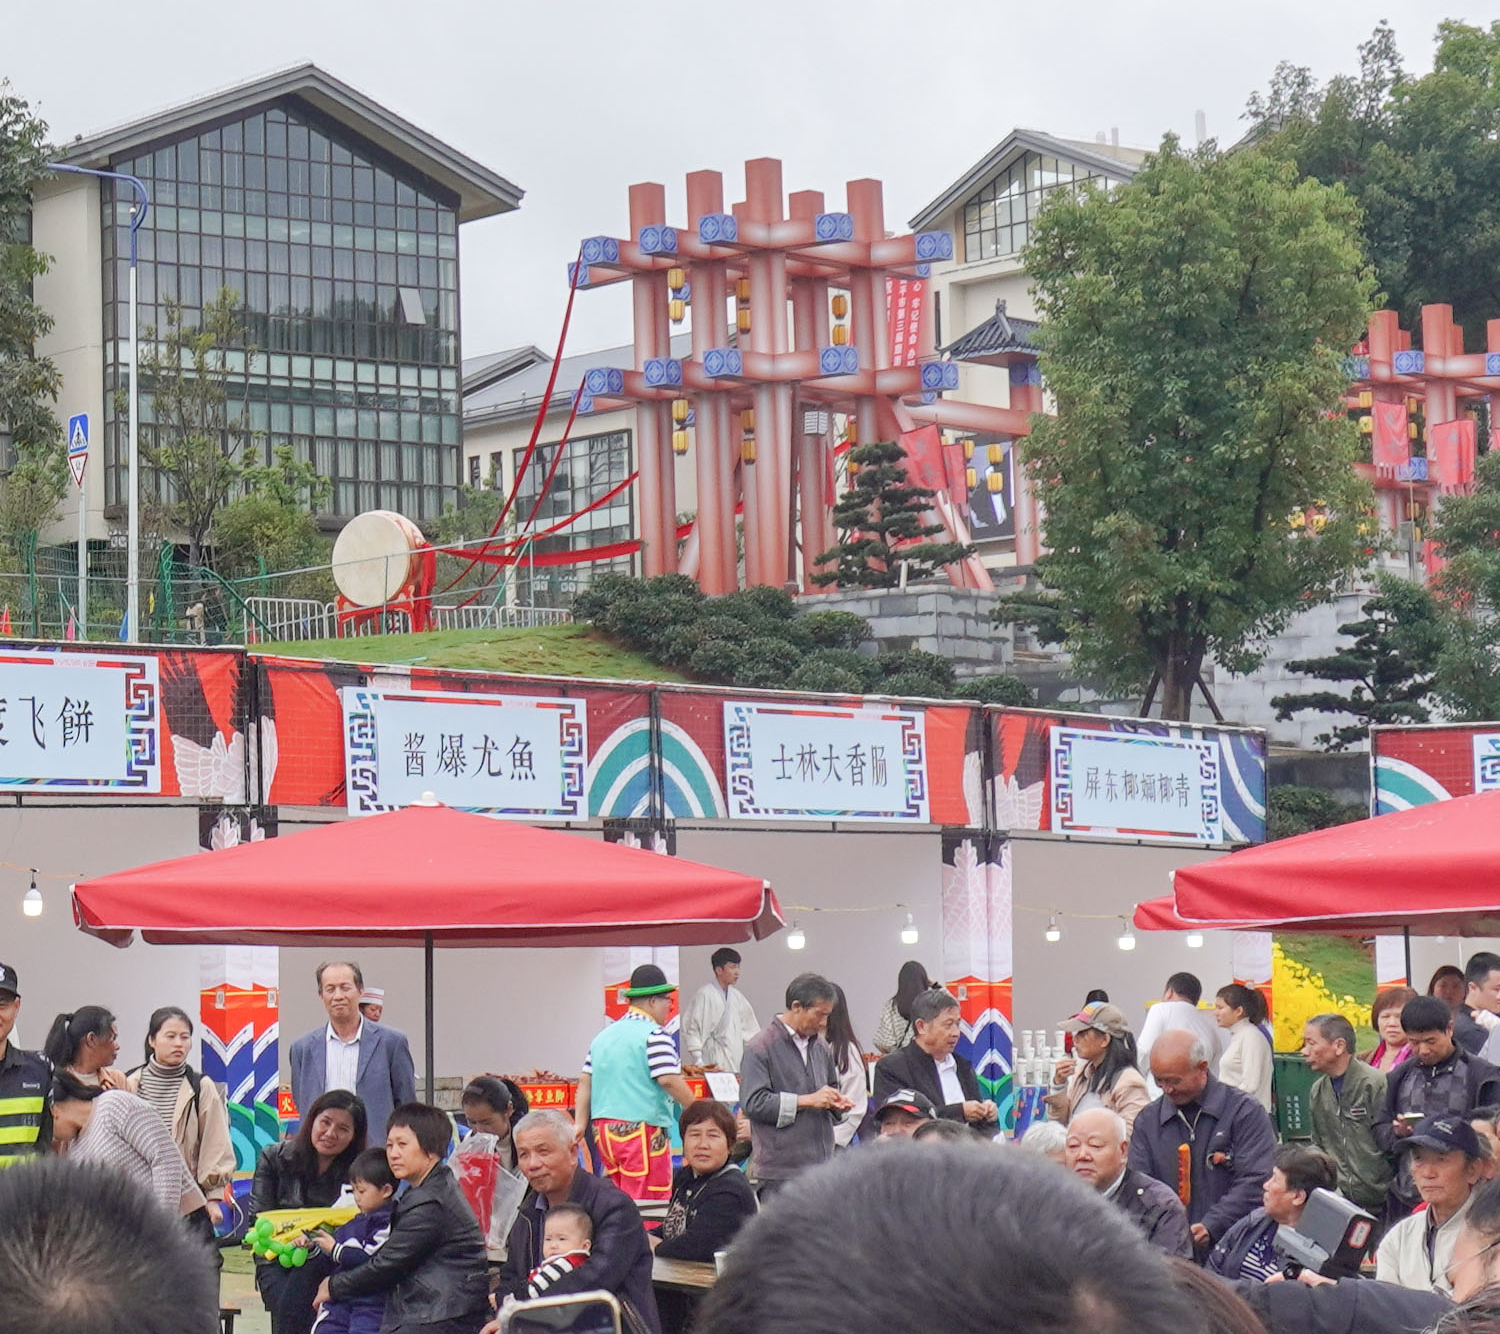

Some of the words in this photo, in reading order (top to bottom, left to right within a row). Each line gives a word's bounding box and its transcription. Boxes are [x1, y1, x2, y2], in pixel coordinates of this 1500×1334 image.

[771, 742, 888, 787] 士林大香肠
